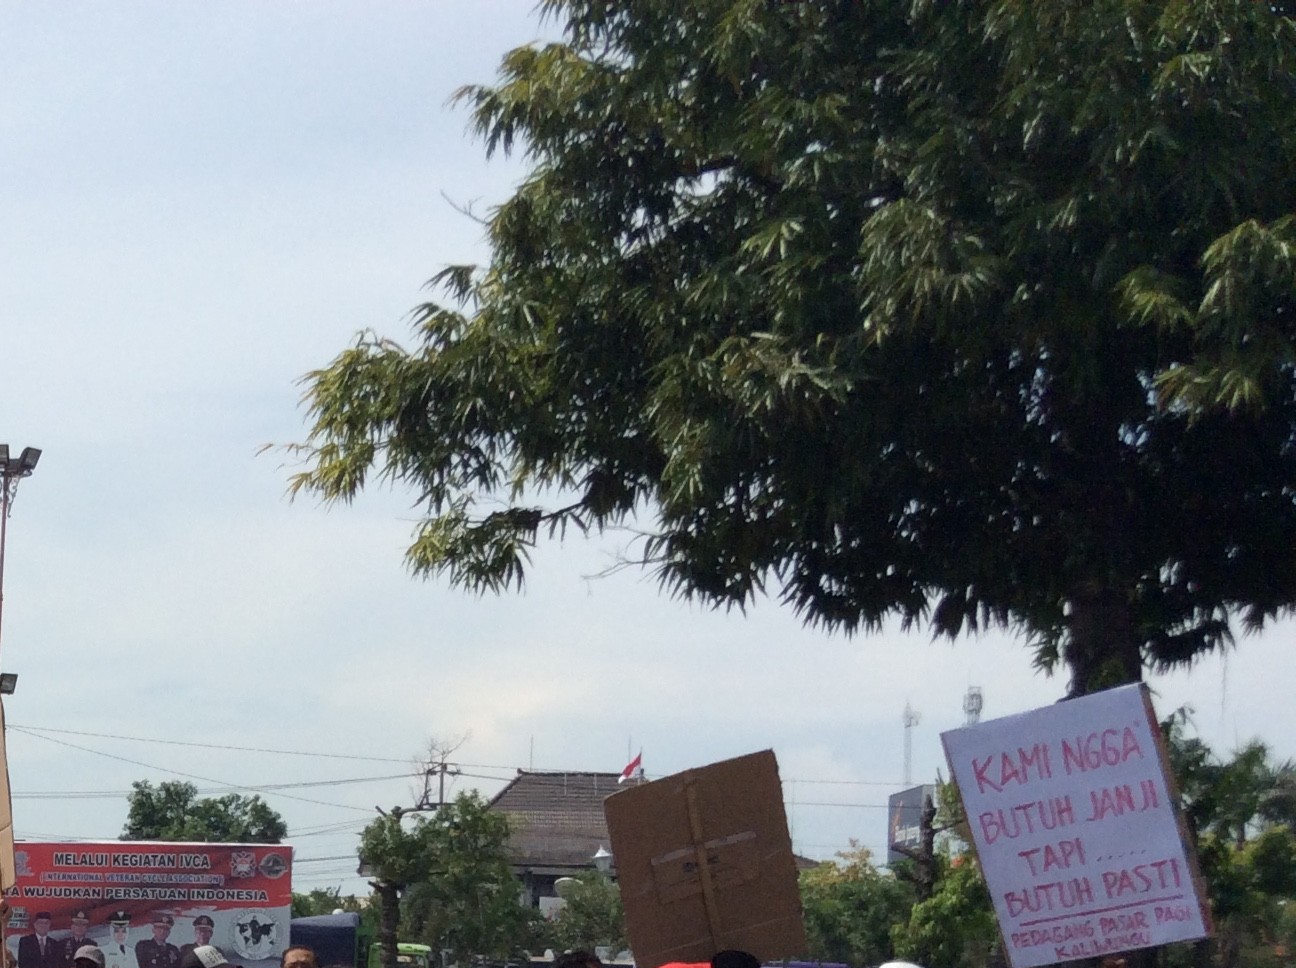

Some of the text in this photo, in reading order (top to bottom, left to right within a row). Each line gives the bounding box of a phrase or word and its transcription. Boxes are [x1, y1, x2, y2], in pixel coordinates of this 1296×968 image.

[972, 743, 1052, 794] KAMI
[979, 795, 1074, 845] BUTUH
[53, 853, 211, 869] MELALUI KEGIATAN IVCA
[1018, 837, 1086, 876] TAPI
[23, 888, 101, 898] WUJUDKAN
[105, 888, 187, 900] PERSATUAN
[191, 890, 269, 901] INDONESIA
[1004, 858, 1182, 918] BUTUH PASTI
[1011, 921, 1094, 948] PEDAGANG
[1099, 911, 1150, 936] PASAR
